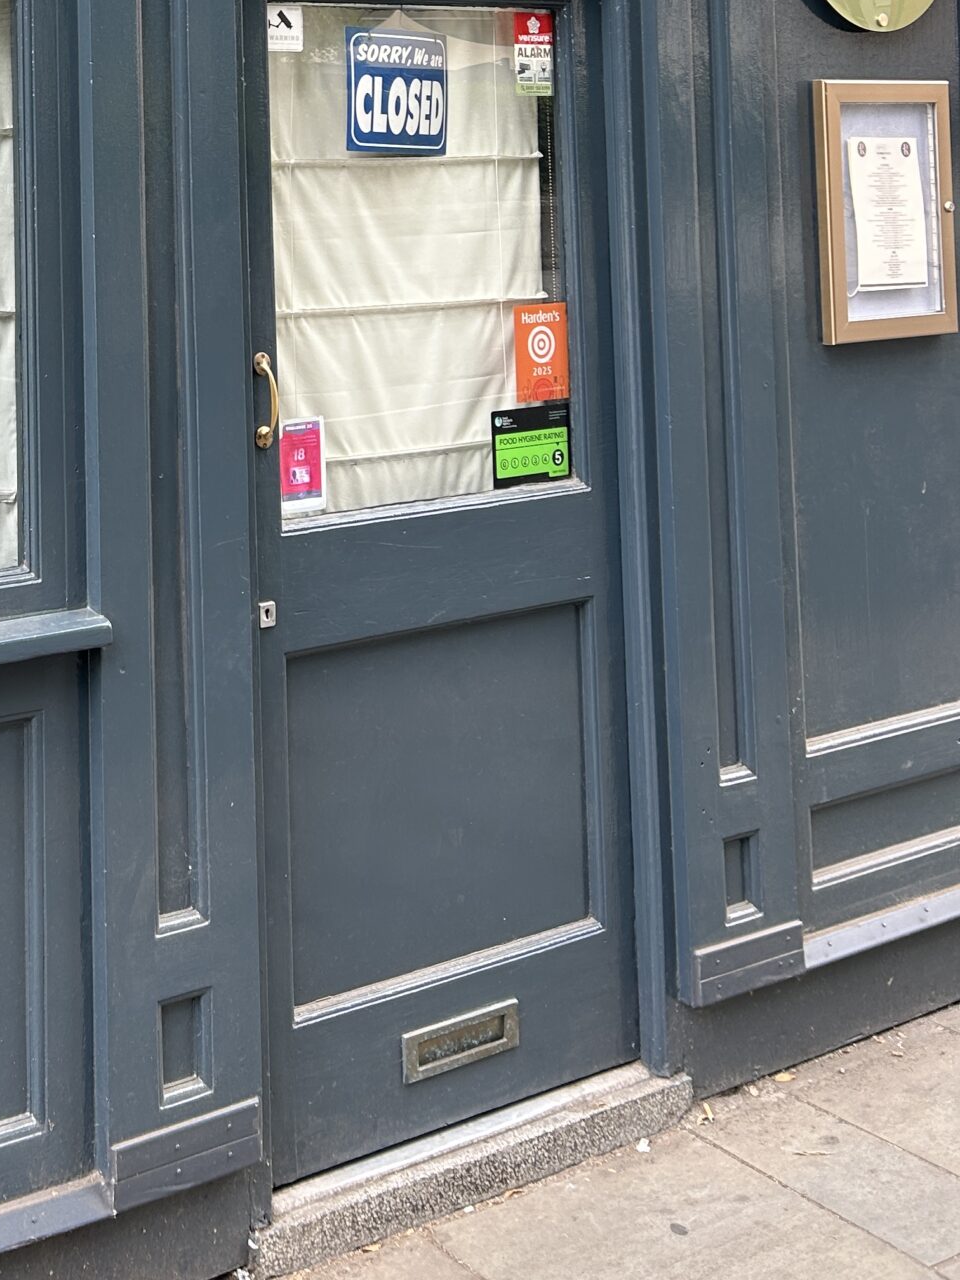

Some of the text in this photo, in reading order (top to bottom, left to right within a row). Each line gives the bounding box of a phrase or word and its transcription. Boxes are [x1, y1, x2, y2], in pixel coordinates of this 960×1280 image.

[356, 43, 443, 67] SORRY, We are
[518, 47, 552, 58] ALARM
[355, 74, 443, 136] CLOSED
[521, 310, 560, 324] Harden's
[532, 366, 552, 376] 2025
[499, 431, 565, 446] FOOD HYGIENE RATING
[294, 448, 305, 461] 18
[554, 451, 562, 464] 5
